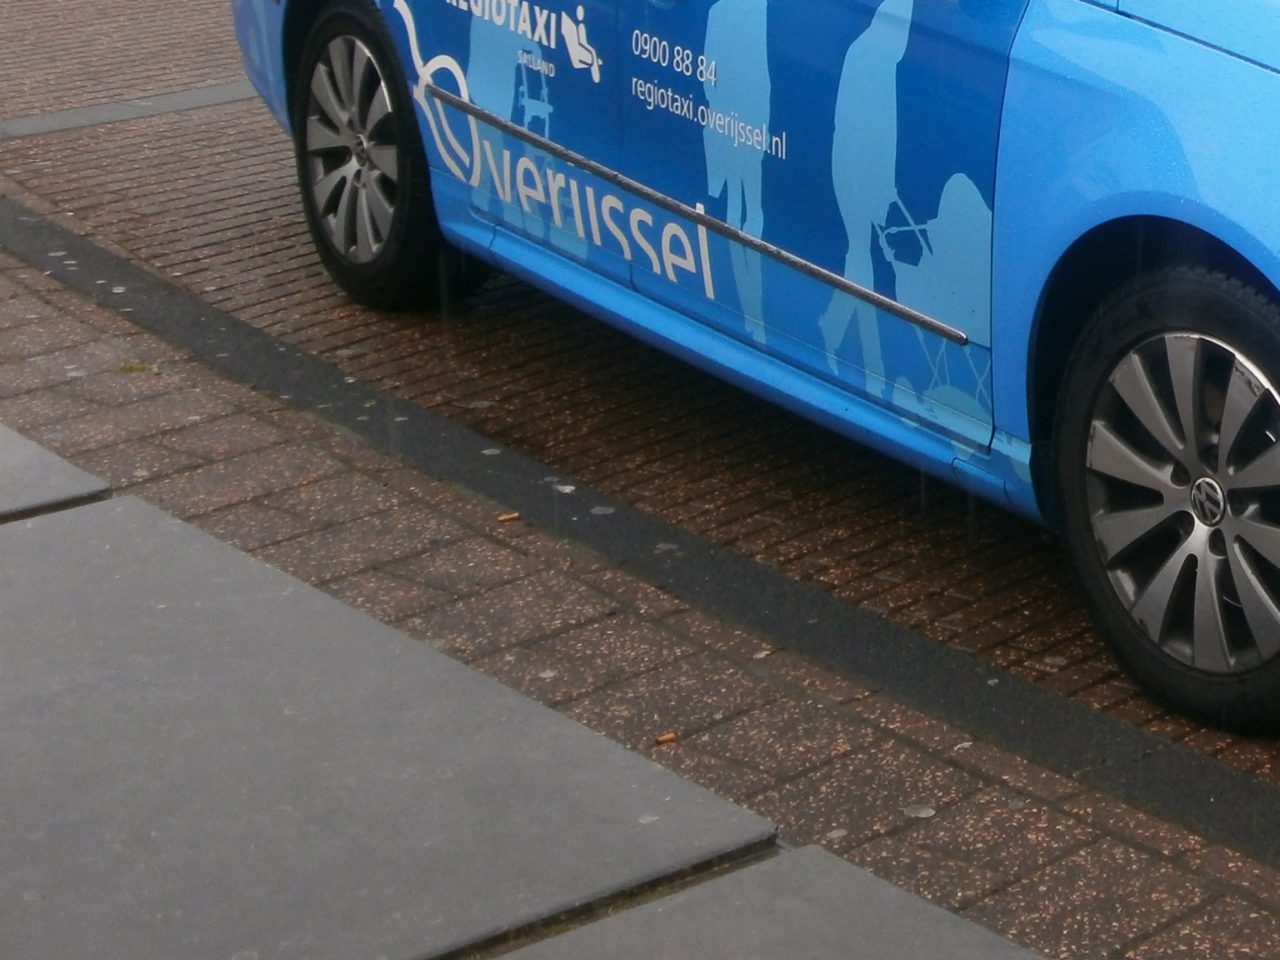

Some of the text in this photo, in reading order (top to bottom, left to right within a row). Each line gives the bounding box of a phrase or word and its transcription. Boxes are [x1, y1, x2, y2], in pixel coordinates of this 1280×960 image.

[518, 48, 555, 78] SALLAND
[632, 30, 717, 86] 0900 88 84
[632, 75, 786, 160] regiotaxi.overijssel.nl
